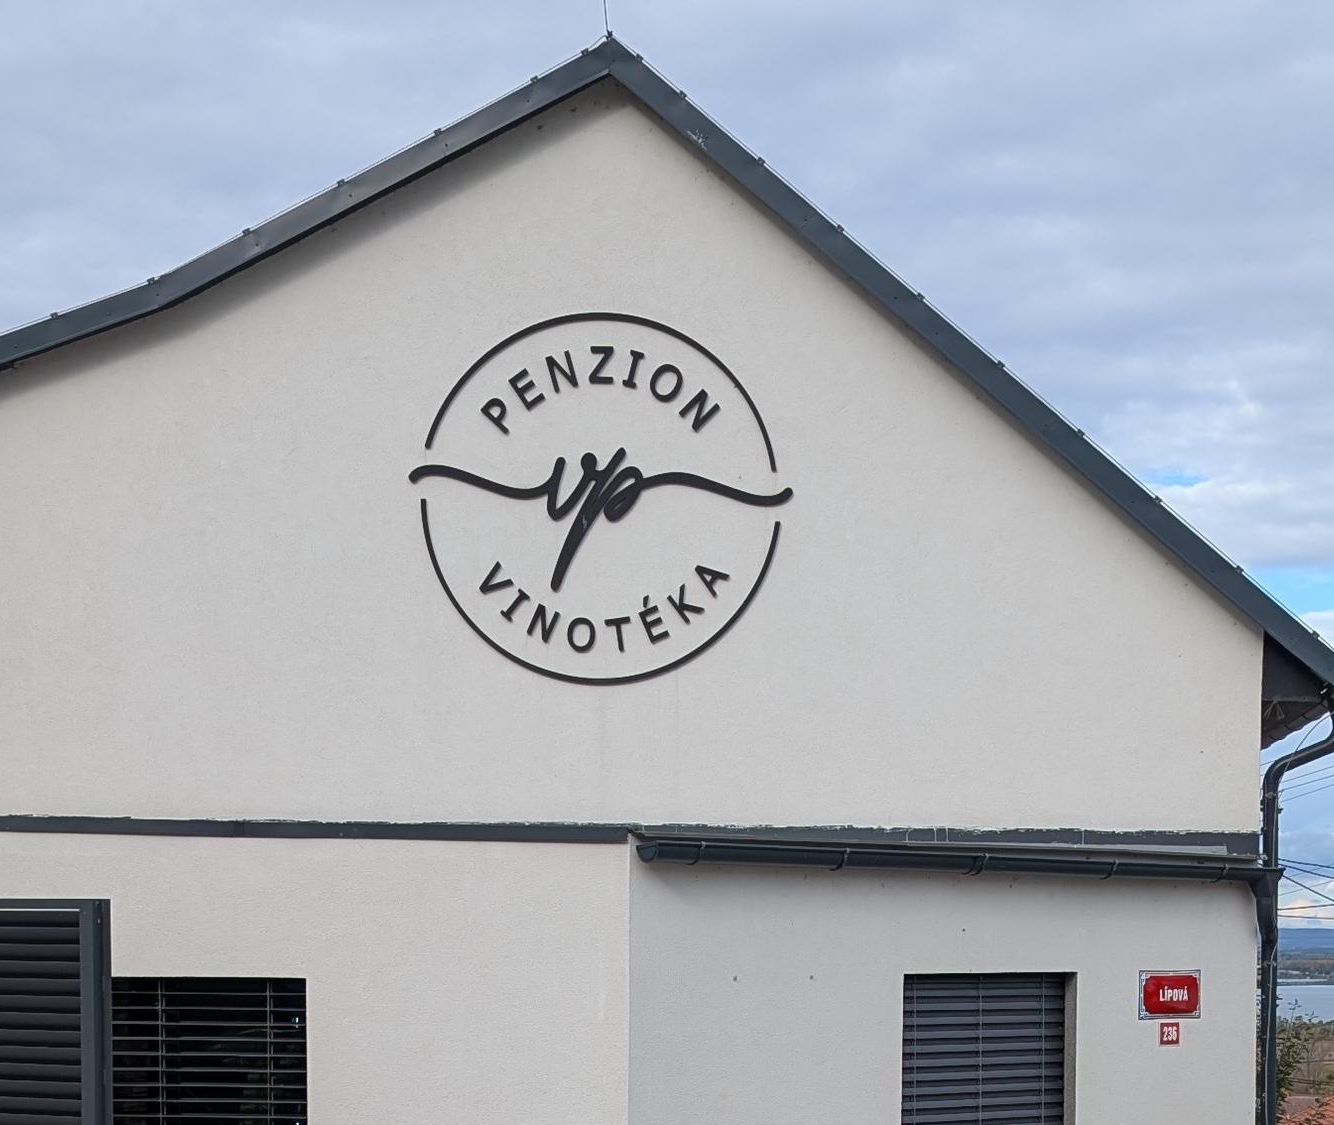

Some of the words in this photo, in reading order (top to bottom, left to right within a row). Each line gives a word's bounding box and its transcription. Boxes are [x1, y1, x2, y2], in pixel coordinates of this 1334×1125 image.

[480, 345, 721, 435] PENZION
[479, 561, 730, 653] VINOTÉKA
[1159, 986, 1188, 1002] LÍPOVÁ
[1163, 1026, 1177, 1041] 236
